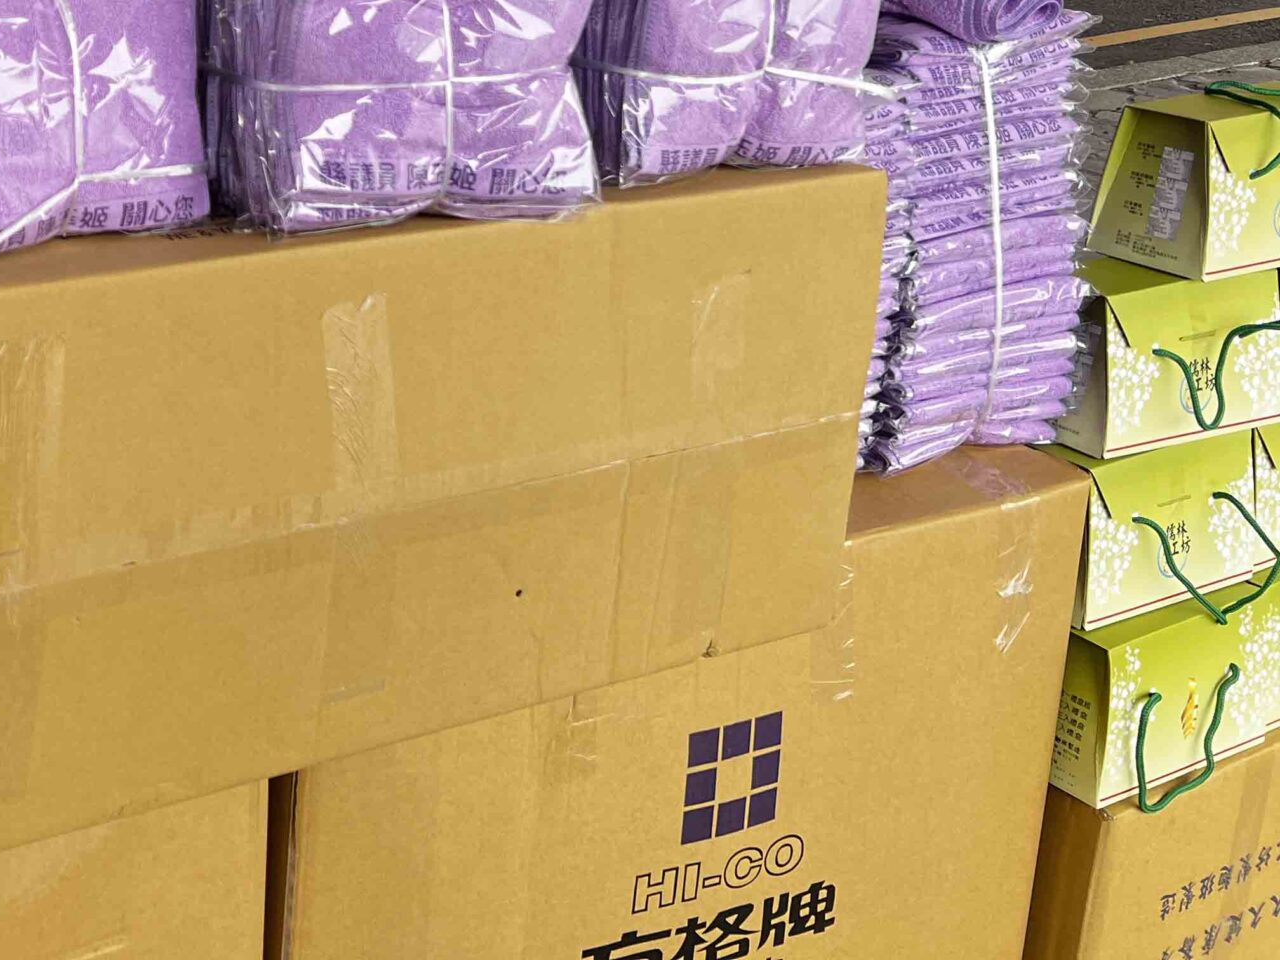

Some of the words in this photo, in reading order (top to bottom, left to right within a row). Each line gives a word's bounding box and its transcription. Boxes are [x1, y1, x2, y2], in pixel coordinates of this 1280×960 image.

[319, 159, 396, 192] 縣議員
[120, 194, 194, 227] 關心您
[630, 833, 805, 915] HI-CO
